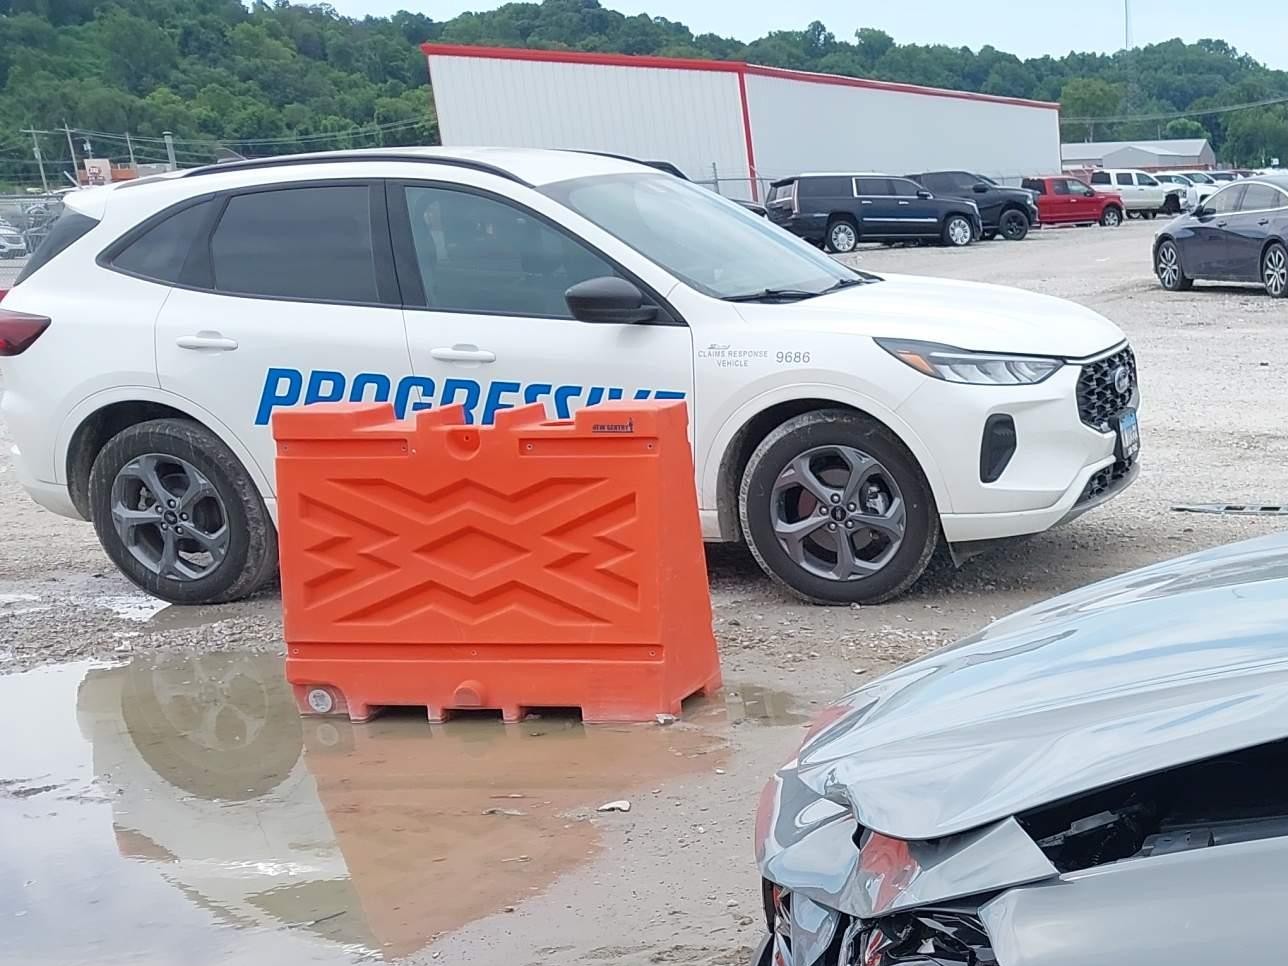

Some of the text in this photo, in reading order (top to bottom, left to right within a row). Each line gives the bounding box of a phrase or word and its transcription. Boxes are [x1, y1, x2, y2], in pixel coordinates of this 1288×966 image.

[697, 350, 769, 358] CLAIMS RESPONSE
[775, 351, 812, 364] 9686
[716, 359, 749, 368] VEHICLE
[254, 367, 686, 426] PROGRES
